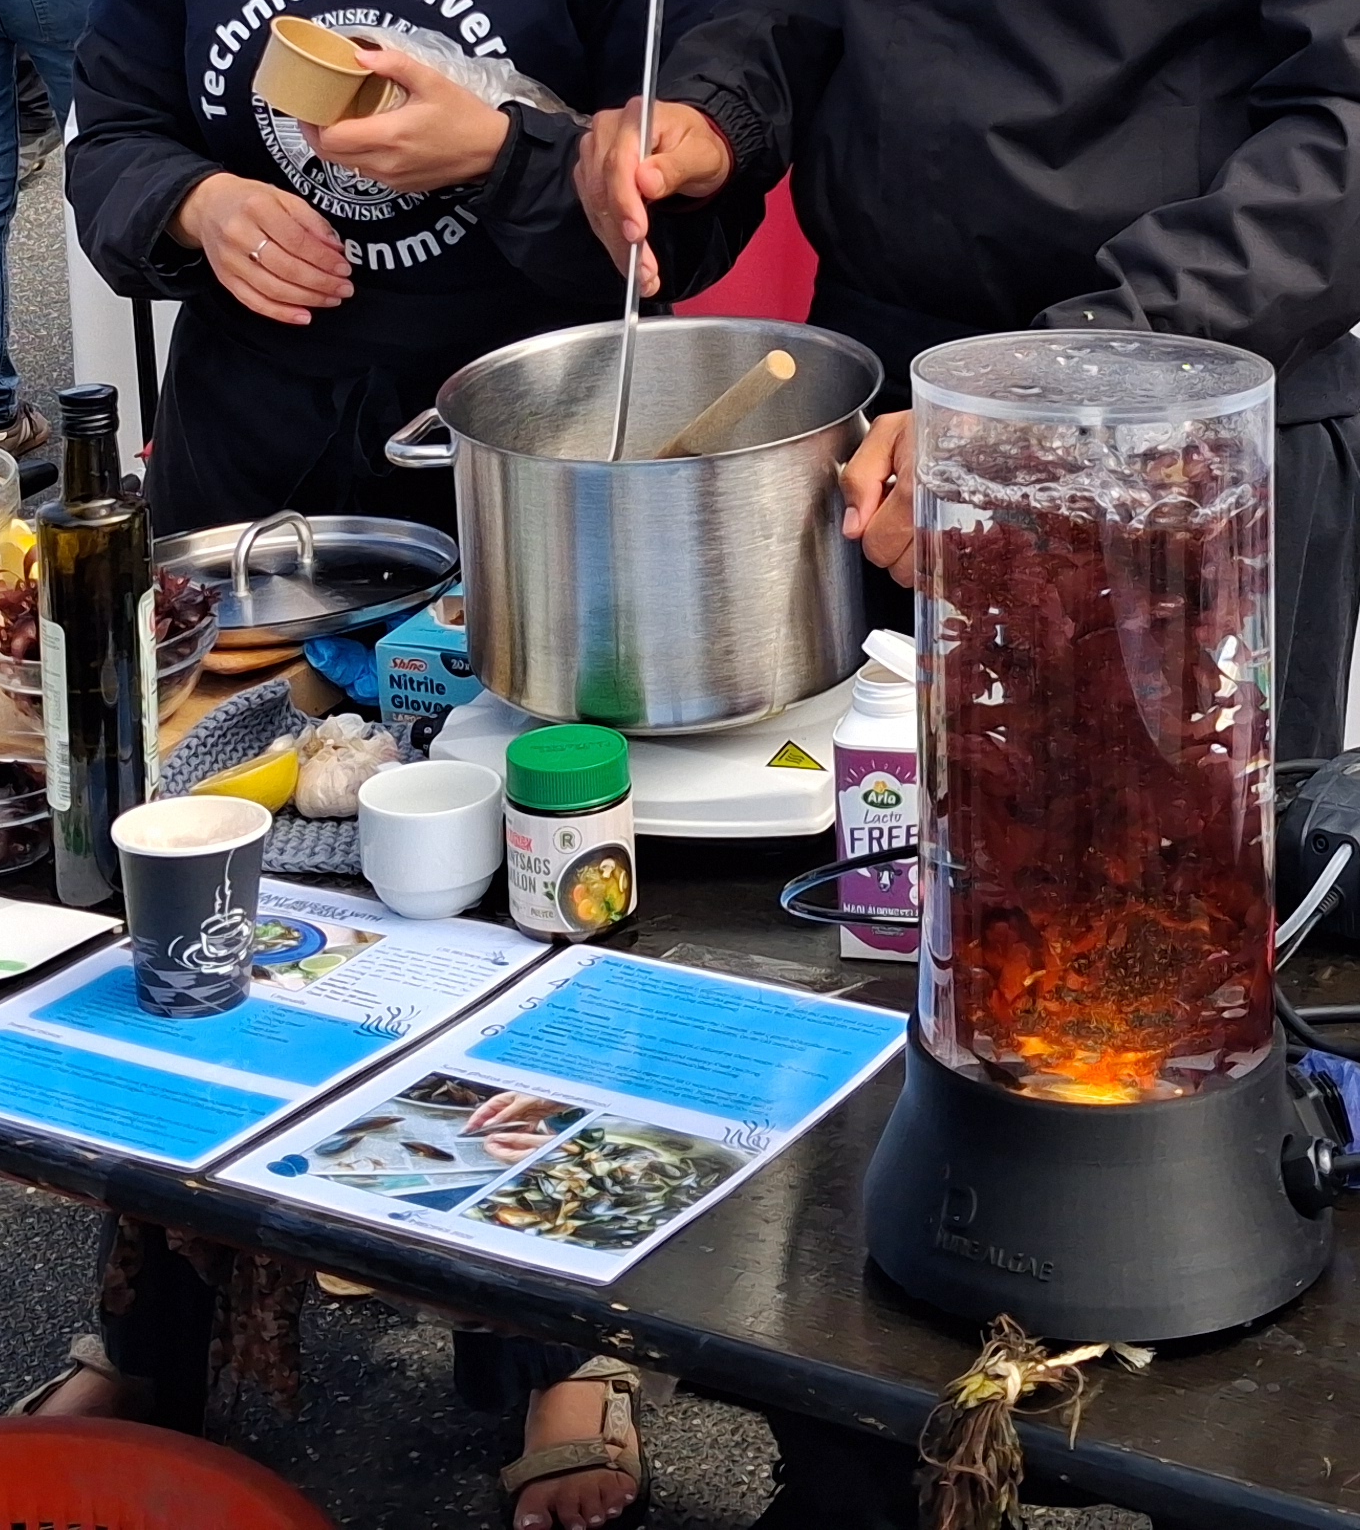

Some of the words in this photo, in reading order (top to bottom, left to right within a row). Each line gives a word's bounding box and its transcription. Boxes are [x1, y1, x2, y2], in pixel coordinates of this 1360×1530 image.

[312, 8, 381, 30] KNISKE
[253, 113, 312, 197] DANMARKS
[312, 189, 396, 222] TEKNISKE
[344, 203, 480, 271] enma
[389, 673, 446, 696] Nitrile
[390, 693, 454, 714] Glov
[867, 791, 897, 805] Arla
[862, 808, 903, 825] Lacto
[517, 996, 544, 1010] 5
[480, 1024, 506, 1038] 6
